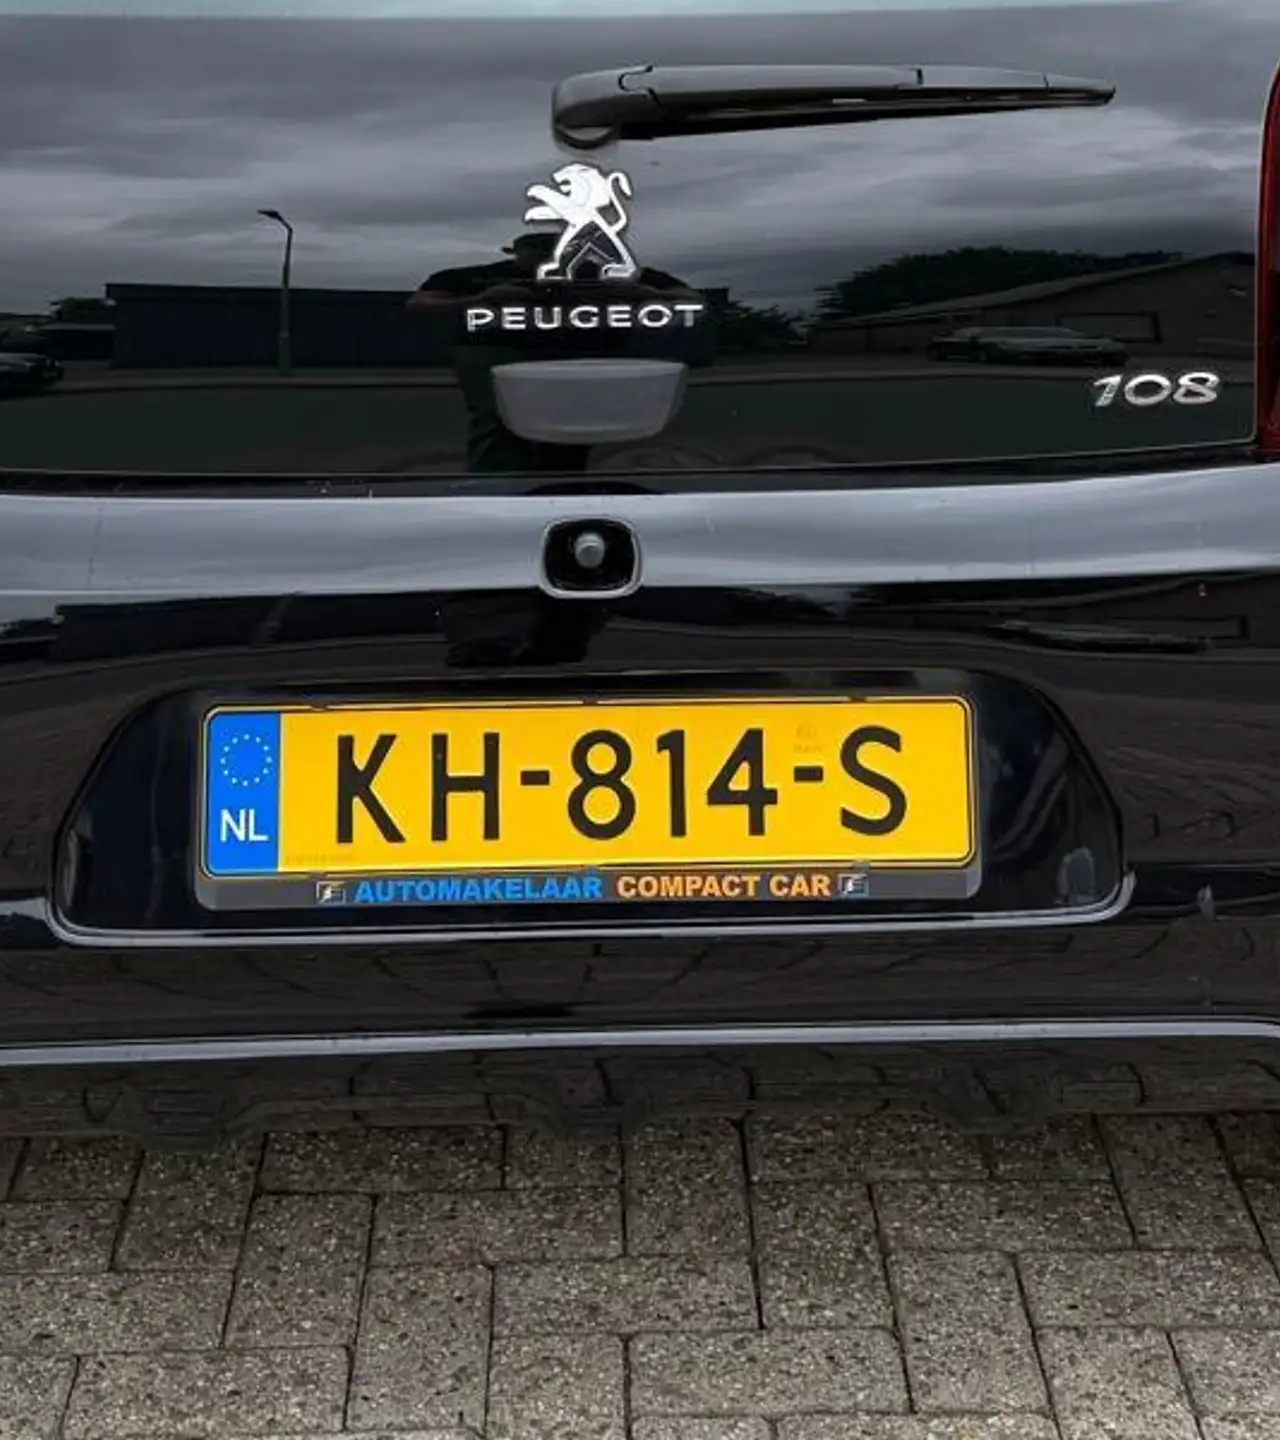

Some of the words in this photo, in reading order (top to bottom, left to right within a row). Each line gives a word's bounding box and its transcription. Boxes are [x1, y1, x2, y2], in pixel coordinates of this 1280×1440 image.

[466, 304, 704, 333] PEUGEOT
[1093, 371, 1221, 409] 108
[333, 723, 909, 846] KH-814-S
[219, 808, 269, 844] NL
[353, 875, 604, 903] AUTOMAKELAAR
[616, 873, 761, 899] COMPACT
[768, 872, 832, 898] CAR
